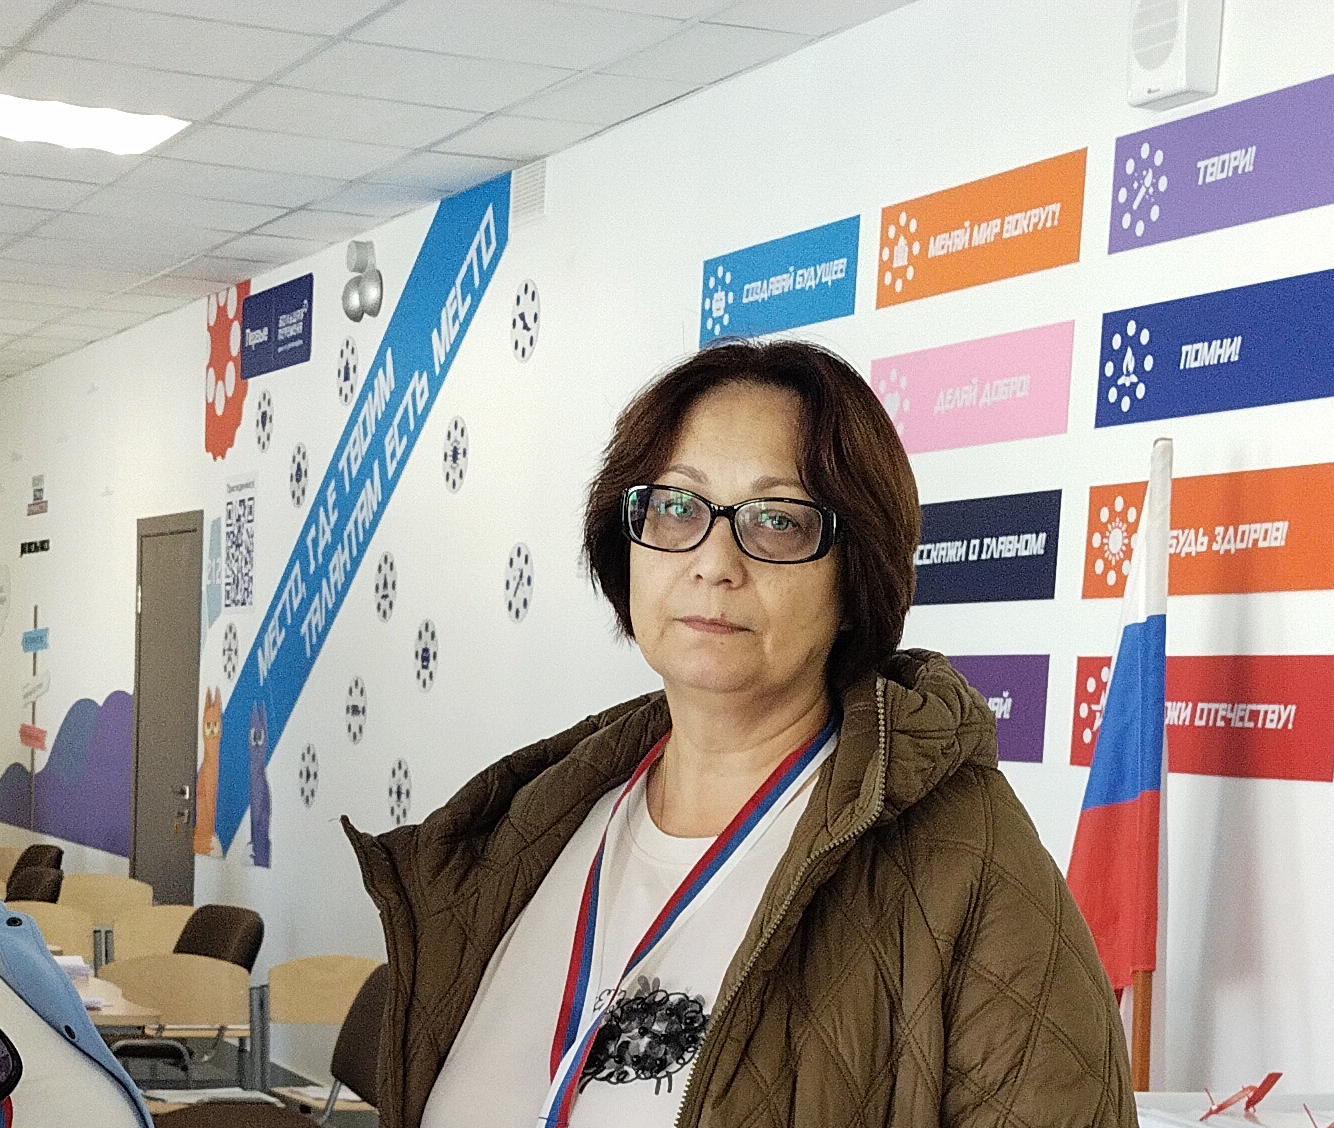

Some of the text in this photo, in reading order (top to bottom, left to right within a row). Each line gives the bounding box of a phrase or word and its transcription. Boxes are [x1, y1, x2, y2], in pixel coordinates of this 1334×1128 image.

[1197, 146, 1256, 187] ТВОРИ!
[928, 202, 1061, 258] МЕНЯЙ МИР ВОКРУГ!
[742, 266, 795, 304] СОЗДАВАЙ
[1179, 336, 1242, 370] ПОМНИ!
[301, 204, 498, 658] ТАЛАНТАМ ЕСТЬ МЕСТО
[257, 347, 396, 686] МЕСТО, ГДЕ ТВОИМ
[913, 532, 1047, 566] ССКАЖИ О ГЛАВНОМ!
[1168, 521, 1289, 557] БУДЬ ЗДОРОВ!
[1194, 702, 1297, 729] ОТЕЧЕСТВУ!
